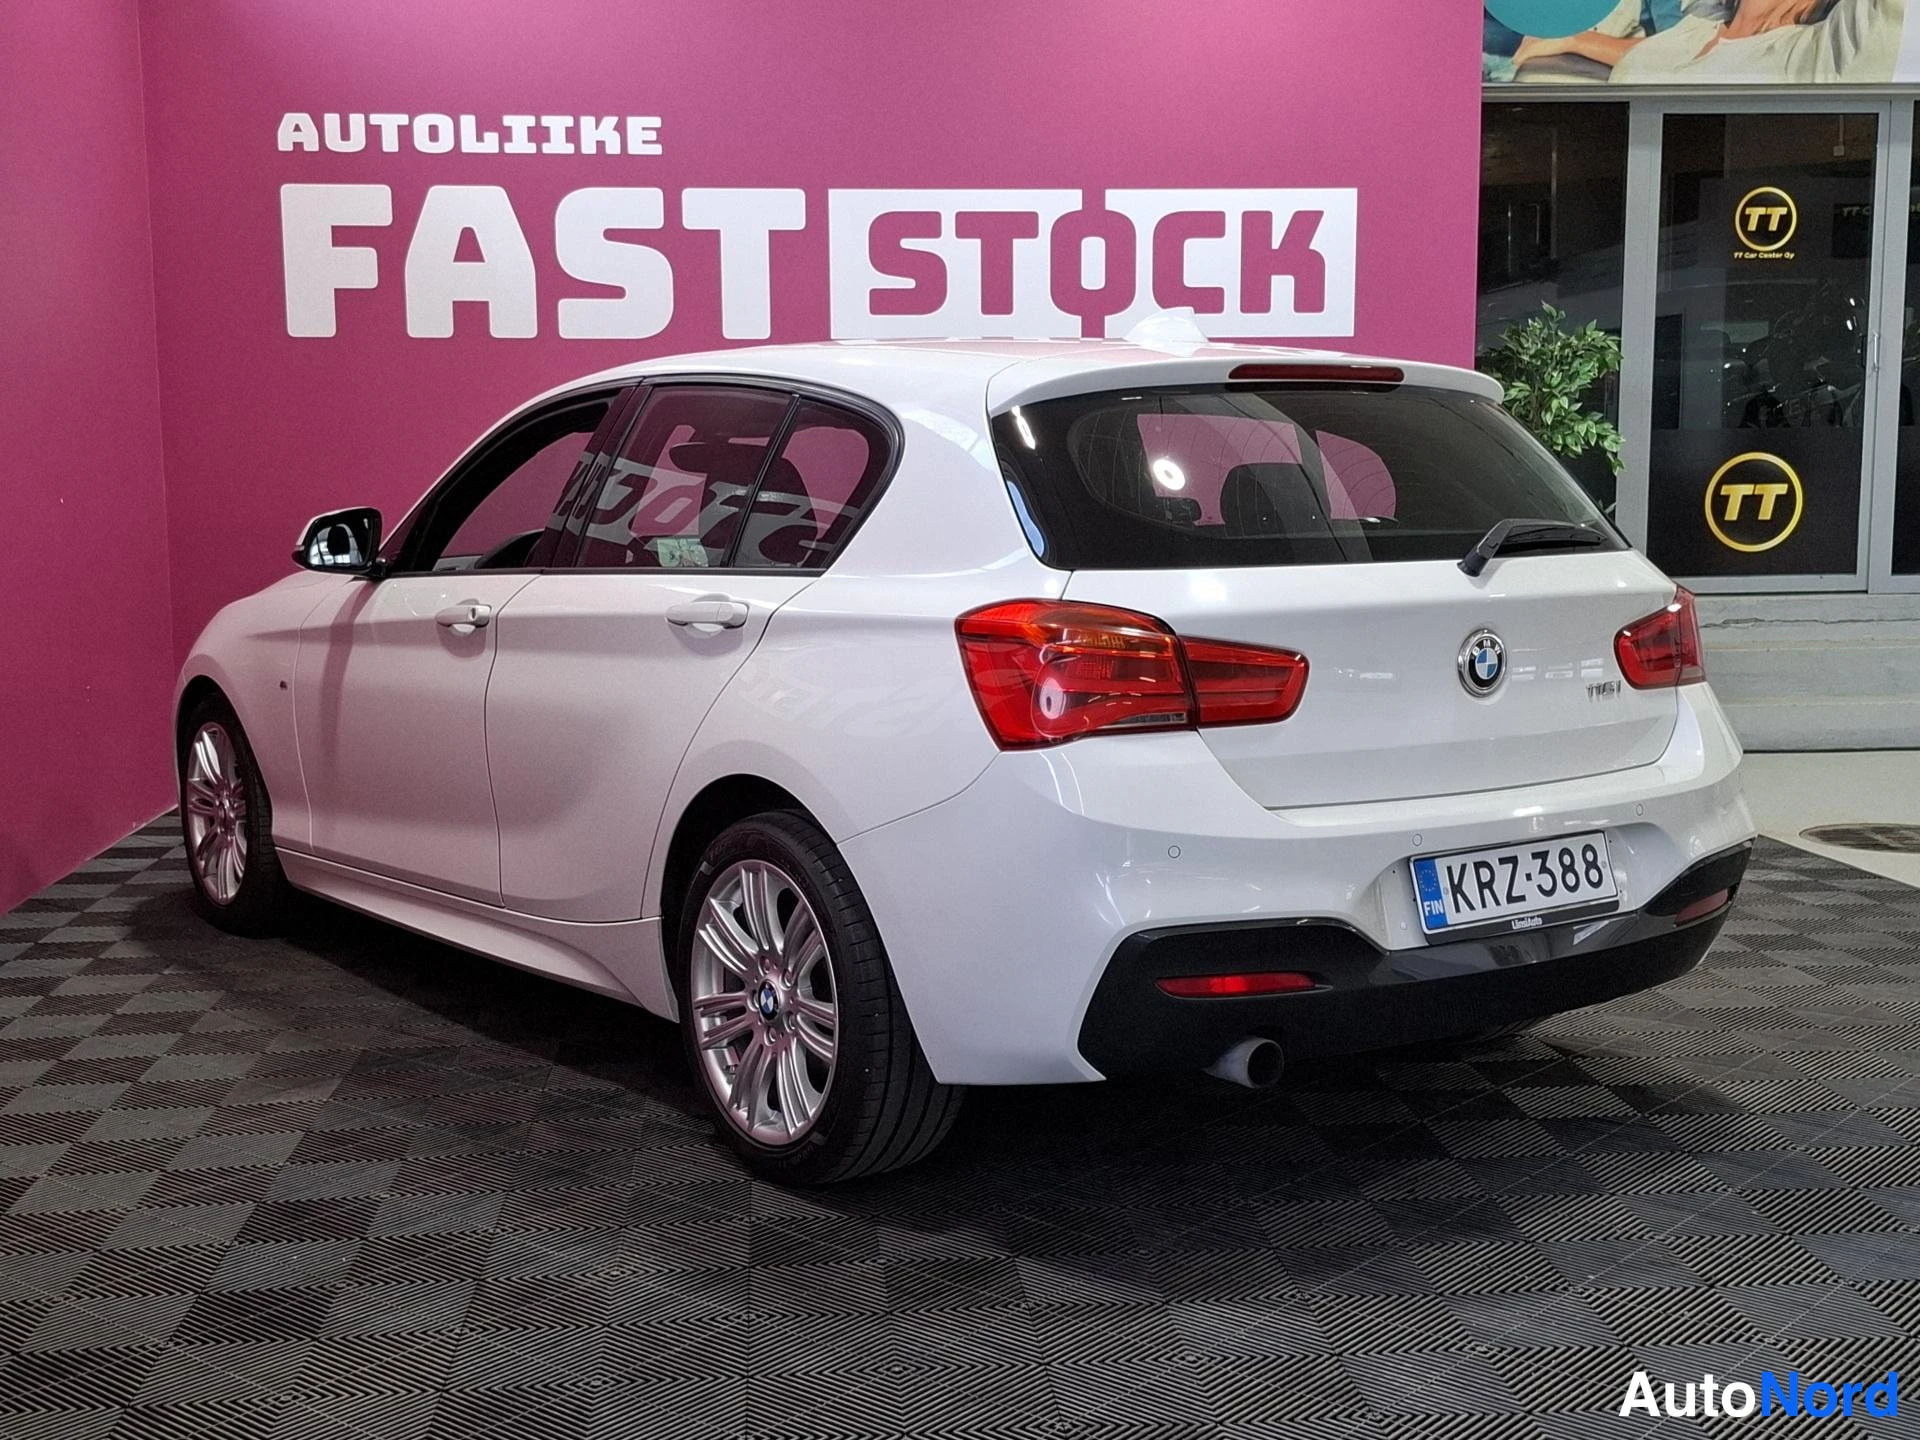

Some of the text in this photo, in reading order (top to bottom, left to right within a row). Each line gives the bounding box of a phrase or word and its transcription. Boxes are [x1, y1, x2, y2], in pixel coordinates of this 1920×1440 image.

[277, 112, 663, 155] AUTOLIIKE
[1744, 206, 1788, 231] TT
[280, 183, 1326, 339] FAST STOCK
[1733, 252, 1744, 260] TT
[1721, 484, 1788, 520] TT
[1447, 843, 1603, 914] KRZ-388
[1424, 901, 1445, 917] FIN
